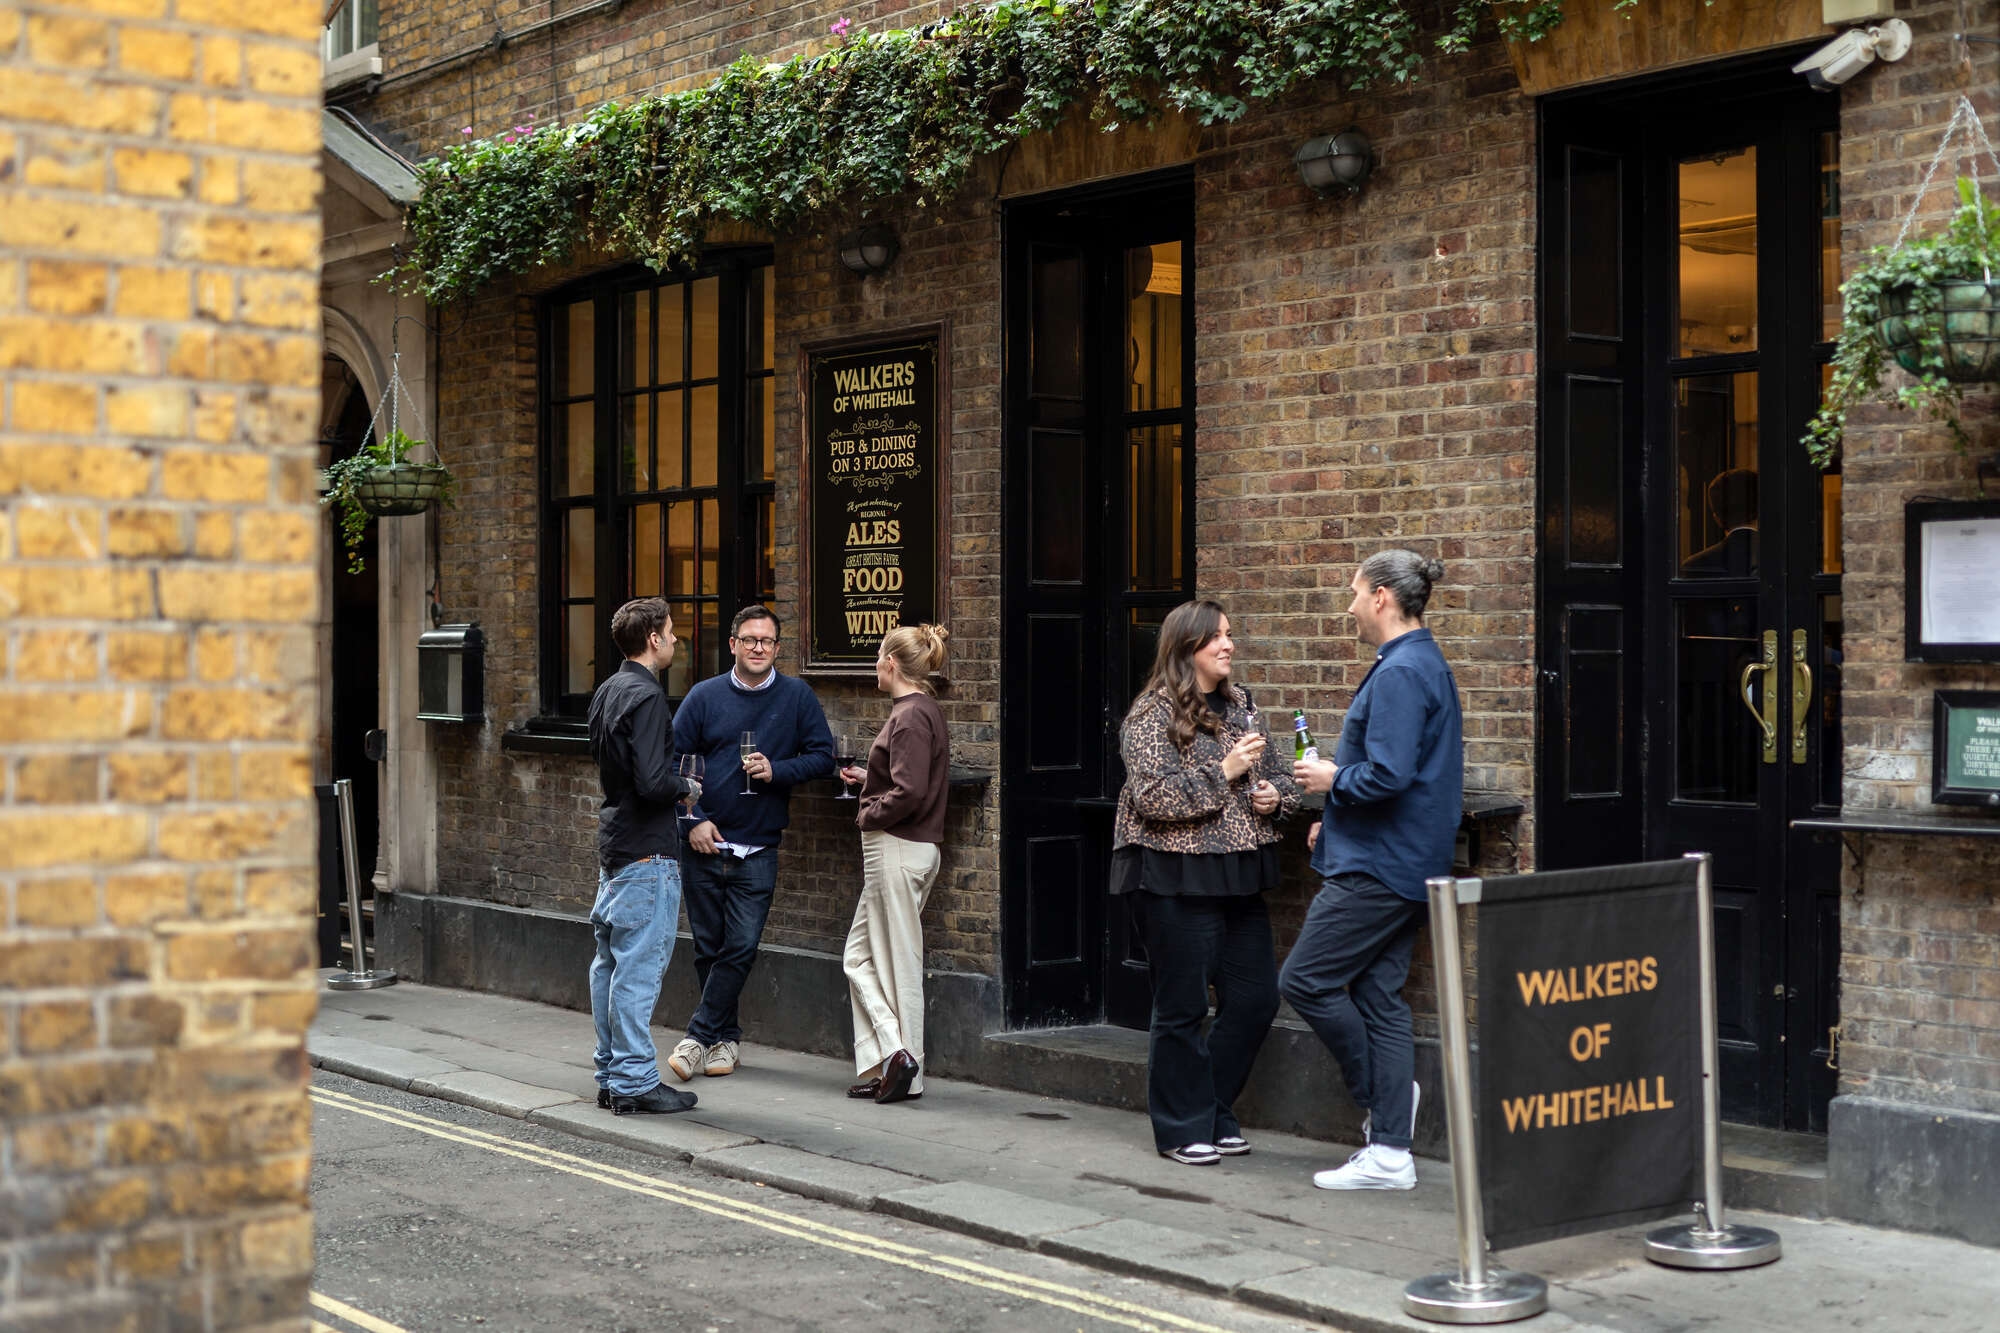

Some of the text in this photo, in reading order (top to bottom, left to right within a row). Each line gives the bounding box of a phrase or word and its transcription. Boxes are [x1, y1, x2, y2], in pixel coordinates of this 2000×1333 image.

[833, 361, 915, 394] WALKERS
[833, 388, 915, 413] OF WHITEHALL
[830, 434, 917, 456] PUB & DINING
[832, 452, 915, 472] ON 3 FLOORS
[846, 501, 854, 512] A
[869, 498, 893, 507] selection
[893, 502, 902, 511] of
[860, 510, 886, 518] REGIONAL
[845, 520, 901, 545] ALES
[846, 553, 900, 567] GREAT BRITISH FAYRE
[842, 567, 903, 592] FOOD
[846, 597, 903, 609] An excellent choice of
[844, 611, 900, 634] WINE
[850, 636, 857, 648] by
[1970, 737, 1999, 746] PLEASE
[1963, 753, 1994, 762] QUIETLY
[1964, 768, 1987, 776] LOCAL
[1517, 956, 1658, 1007] WALKERS
[1569, 1023, 1612, 1062] OF
[1502, 1075, 1674, 1134] WHITEHALL
